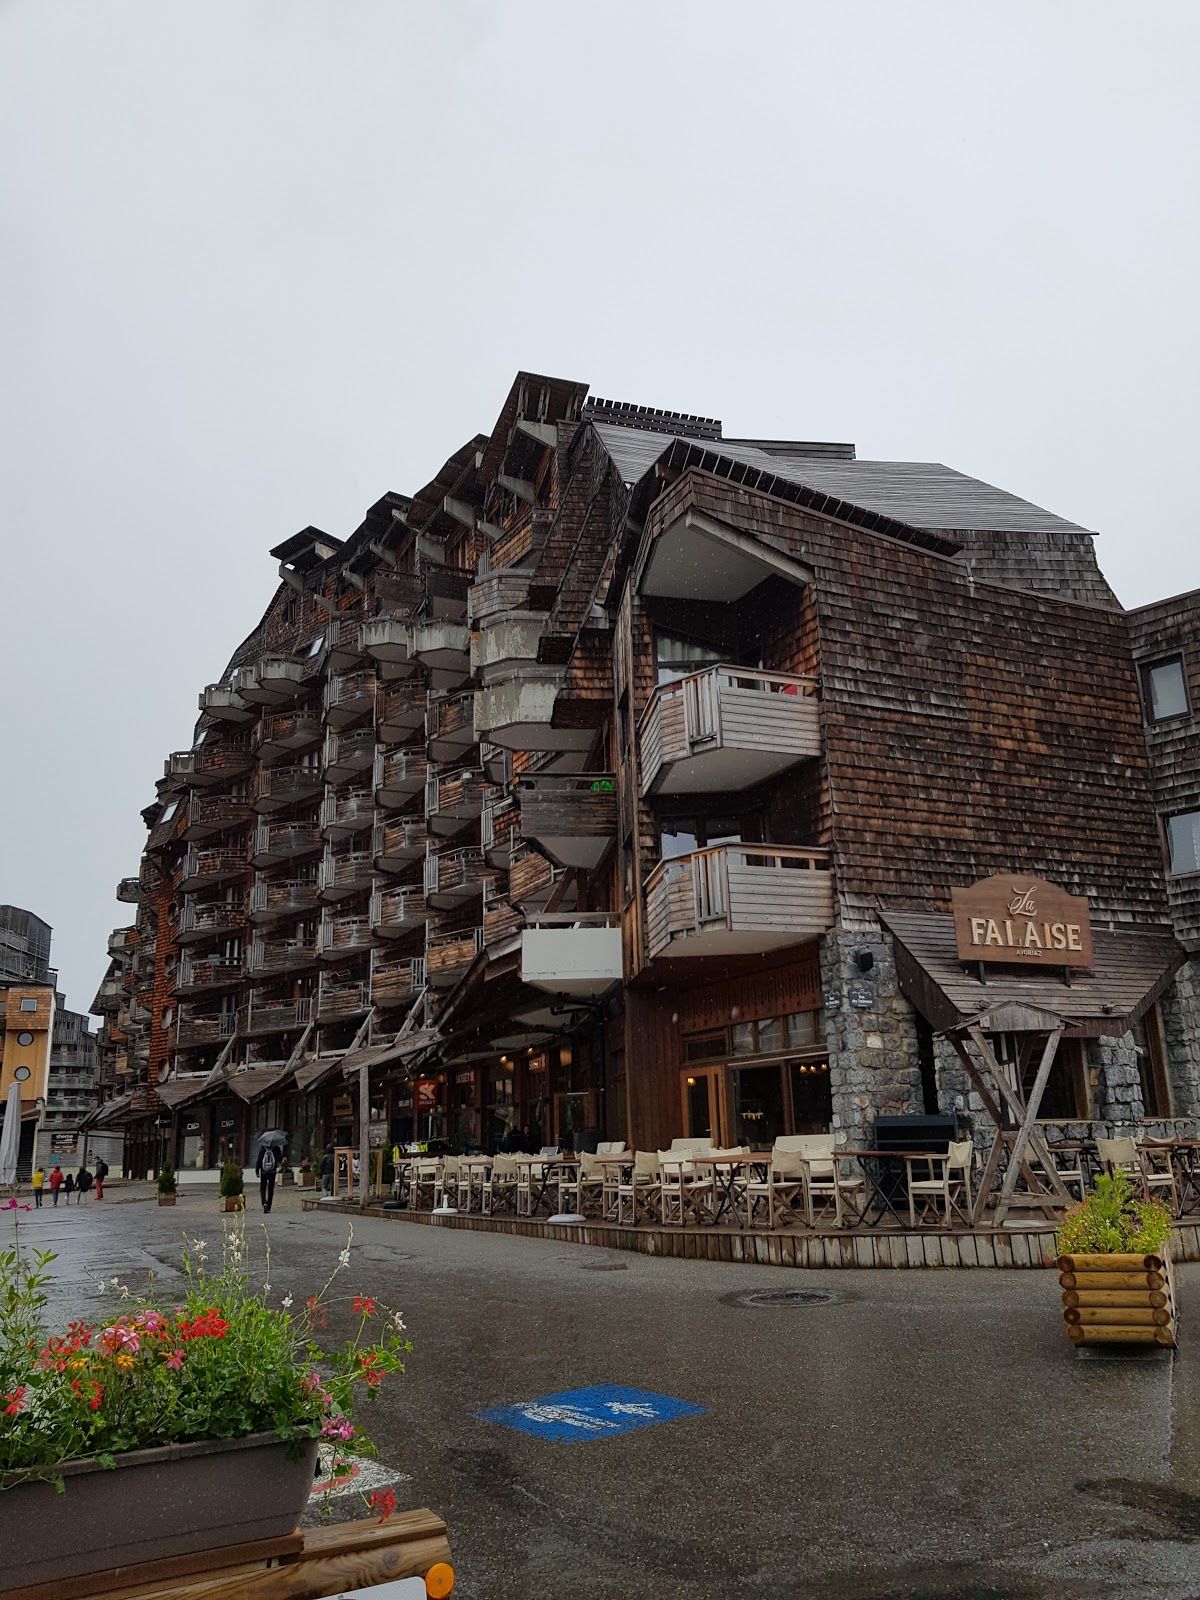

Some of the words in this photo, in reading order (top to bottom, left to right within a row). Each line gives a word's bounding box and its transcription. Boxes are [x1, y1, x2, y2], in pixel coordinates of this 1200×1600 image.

[1007, 886, 1037, 917] La
[969, 917, 1083, 951] FALAISE
[1016, 949, 1043, 957] AVORIAZ
